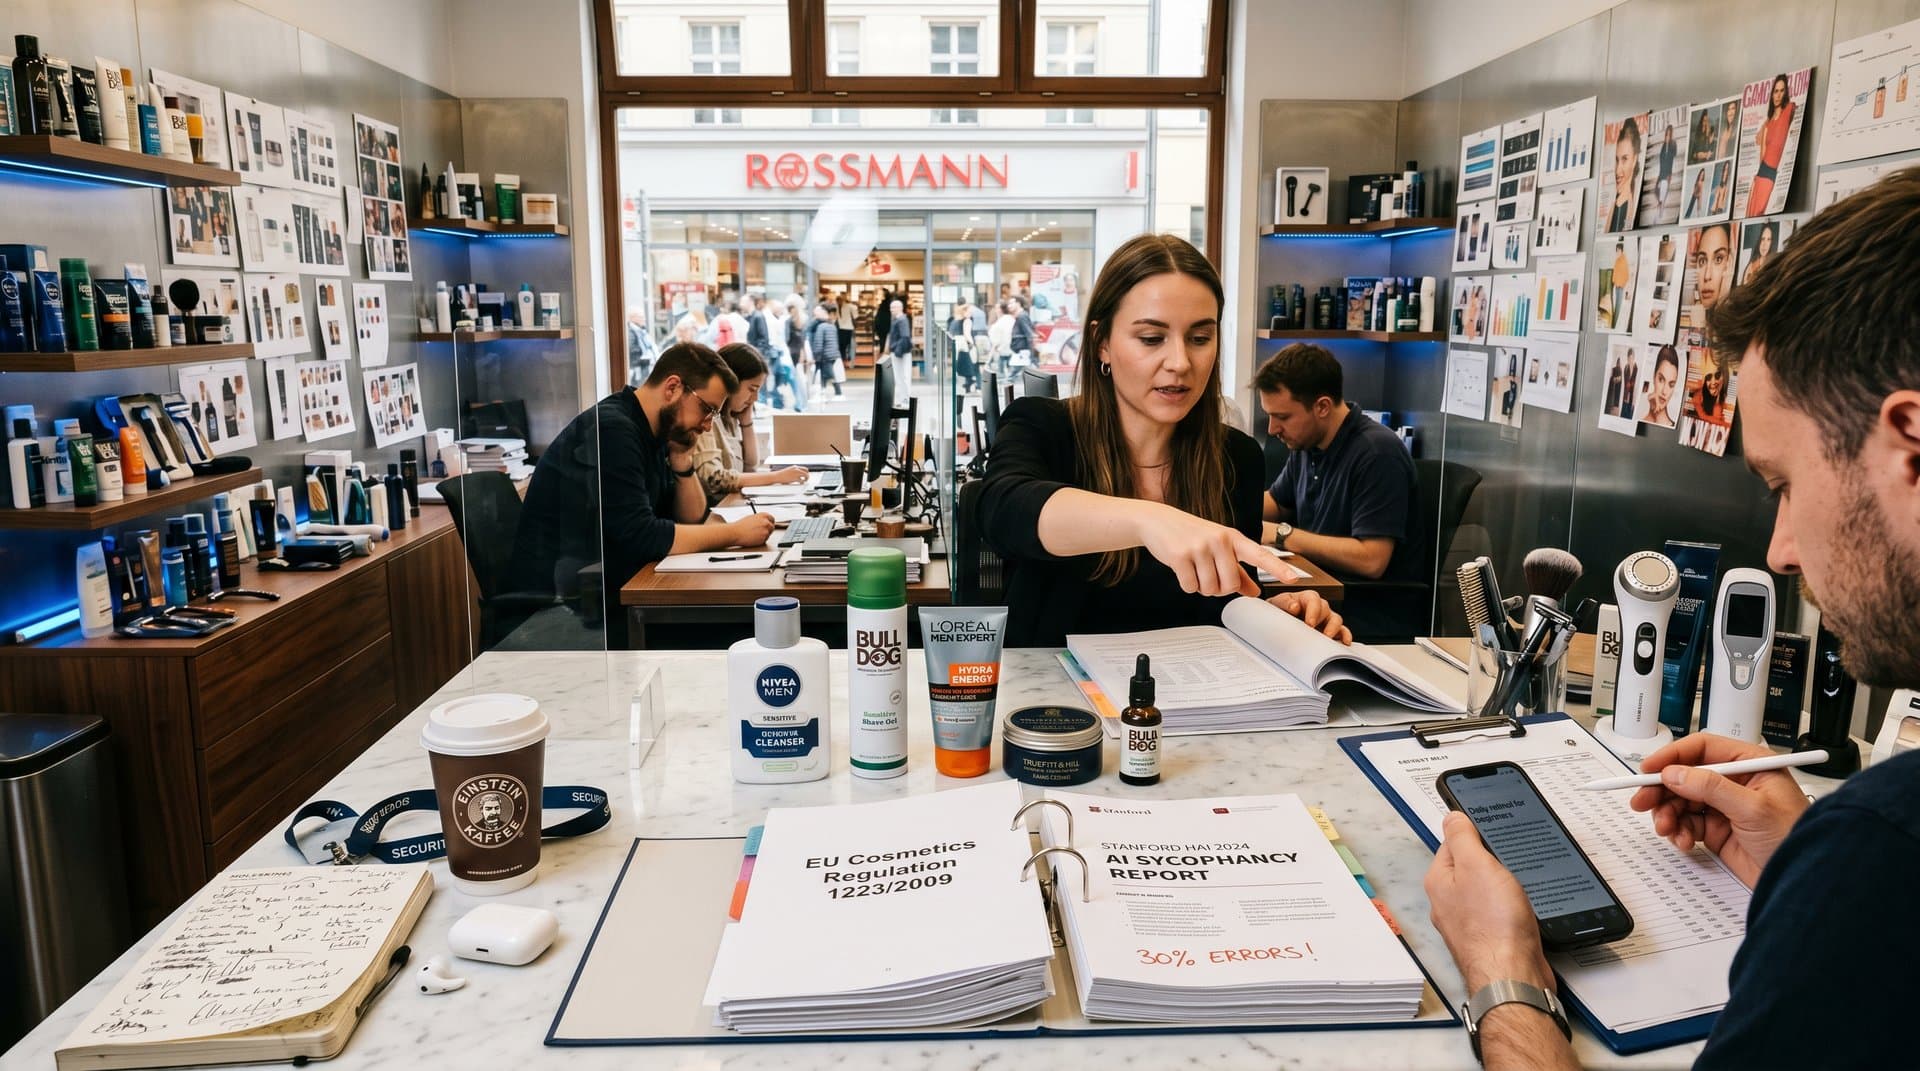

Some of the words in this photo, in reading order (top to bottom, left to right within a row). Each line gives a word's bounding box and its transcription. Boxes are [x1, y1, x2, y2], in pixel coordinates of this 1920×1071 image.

[746, 153, 1008, 192] ROSSMANN
[930, 620, 997, 633] L'ORÉAL
[856, 629, 902, 648] BULL
[930, 633, 954, 642] MEN
[956, 633, 997, 642] EXPERT
[856, 647, 902, 667] DOG
[958, 665, 993, 674] HYDRA
[762, 678, 797, 688] NIVEA
[952, 675, 993, 684] ENERGY
[764, 687, 793, 696] MEN
[862, 718, 884, 726] Shave
[885, 717, 898, 725] Gel
[755, 737, 805, 748] CLEANSER
[1058, 761, 1065, 769] &
[457, 778, 523, 804] EINSTEIN
[1468, 806, 1489, 815] Daily
[1513, 800, 1526, 808] for
[463, 819, 521, 844] KAFFEE
[391, 839, 447, 859] SECURIT
[1101, 842, 1181, 852] STANFORD
[1184, 843, 1211, 851] HAI
[1213, 842, 1251, 851] 2024
[806, 856, 840, 869] EU
[848, 840, 977, 865] Cosmetics
[1105, 854, 1130, 865] AI
[1135, 852, 1298, 866] SYCOPHANCY
[823, 859, 958, 884] Regulation
[1109, 868, 1210, 881] REPORT
[827, 873, 953, 900] 1223/2009
[1136, 948, 1196, 967] 30%
